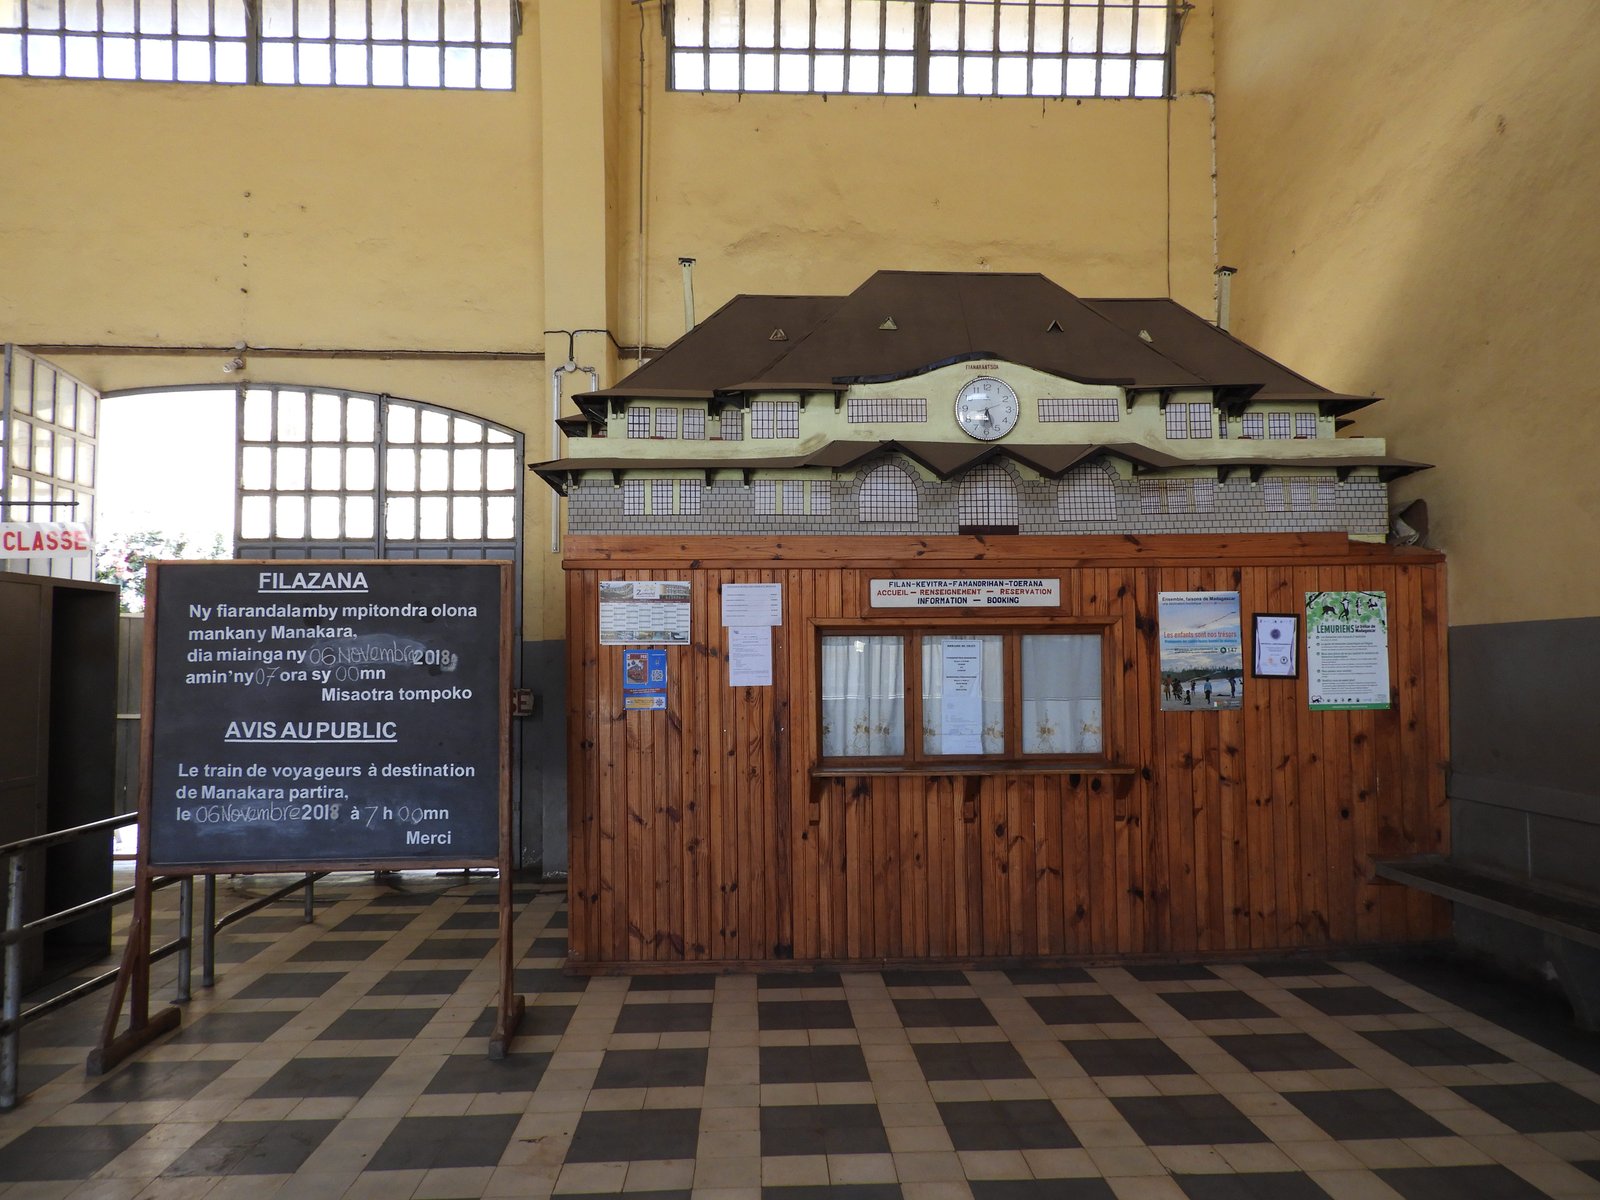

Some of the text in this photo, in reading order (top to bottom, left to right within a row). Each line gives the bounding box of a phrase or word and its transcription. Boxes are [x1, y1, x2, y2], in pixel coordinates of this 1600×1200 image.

[3, 531, 87, 551] CLASSE
[259, 572, 368, 589] FILAZANA
[189, 603, 477, 621] Ny fiarandalamby mpitondra olona
[188, 625, 358, 644] mankany Manakara,
[1317, 623, 1354, 633] LÉMURIENS
[187, 648, 214, 663] dia
[217, 648, 284, 665] miainga
[286, 649, 307, 665] ny
[280, 669, 307, 682] ora
[312, 668, 331, 685] sy
[322, 687, 472, 705] Misaotra tompoko
[225, 720, 397, 739] AVIS AU PUBLIC
[179, 763, 475, 781] Le train de voyageurs à destination
[176, 785, 349, 802] de Manakara partira,
[176, 807, 191, 821] le
[351, 806, 360, 820] à
[364, 805, 379, 829] 7
[383, 806, 393, 821] h
[406, 830, 451, 845] Merci
